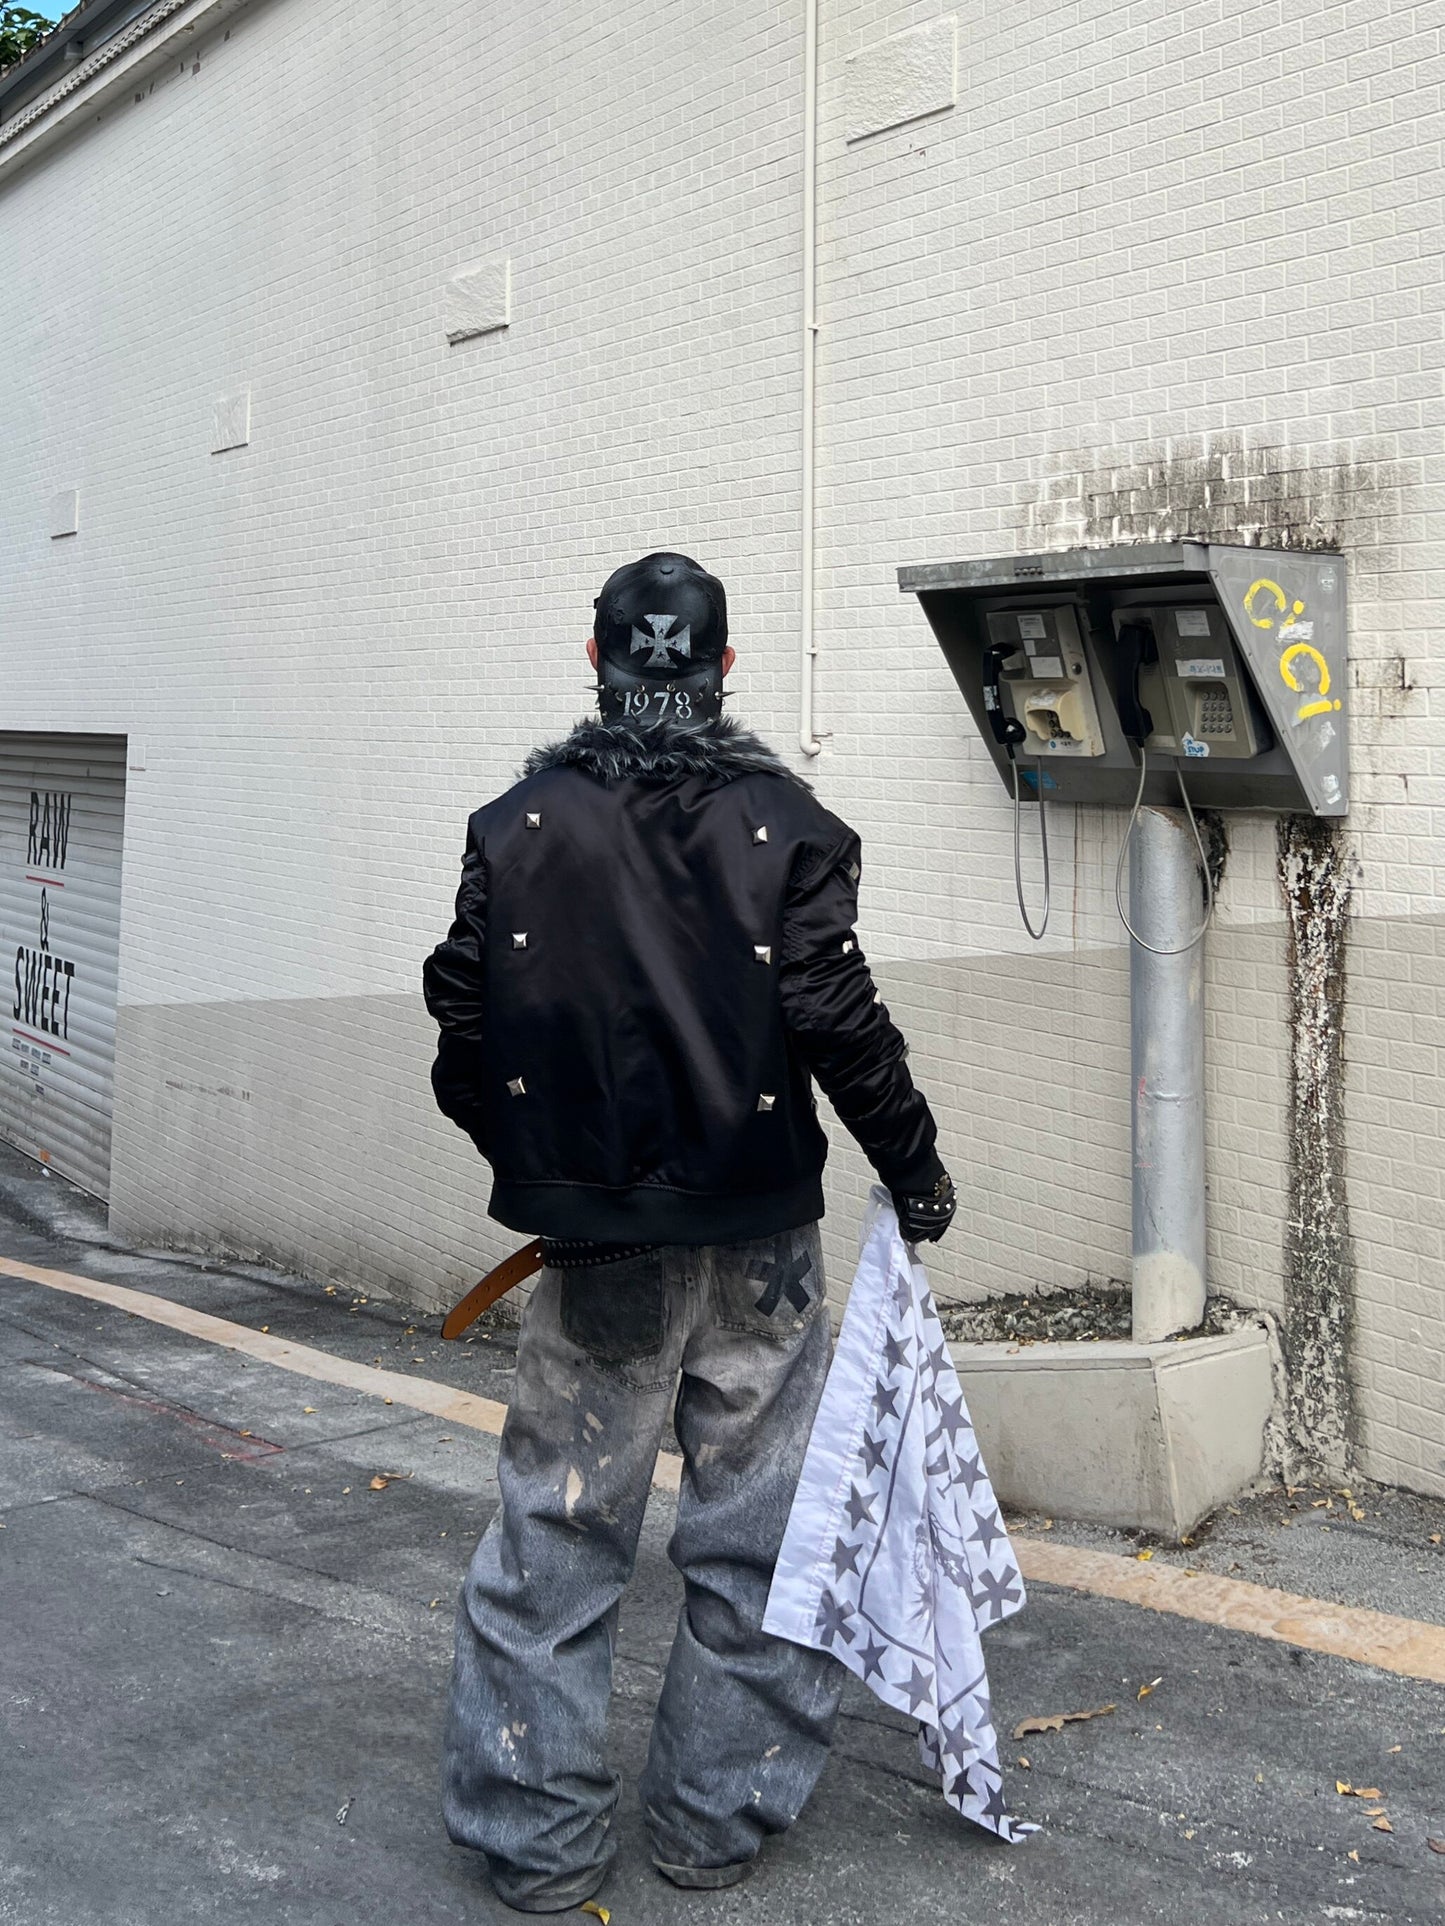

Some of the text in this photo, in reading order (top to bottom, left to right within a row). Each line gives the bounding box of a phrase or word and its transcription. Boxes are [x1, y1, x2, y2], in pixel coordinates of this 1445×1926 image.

[624, 691, 692, 719] 1978
[27, 791, 71, 870] RAW
[40, 886, 49, 952] &
[13, 946, 75, 1040] SWEET
